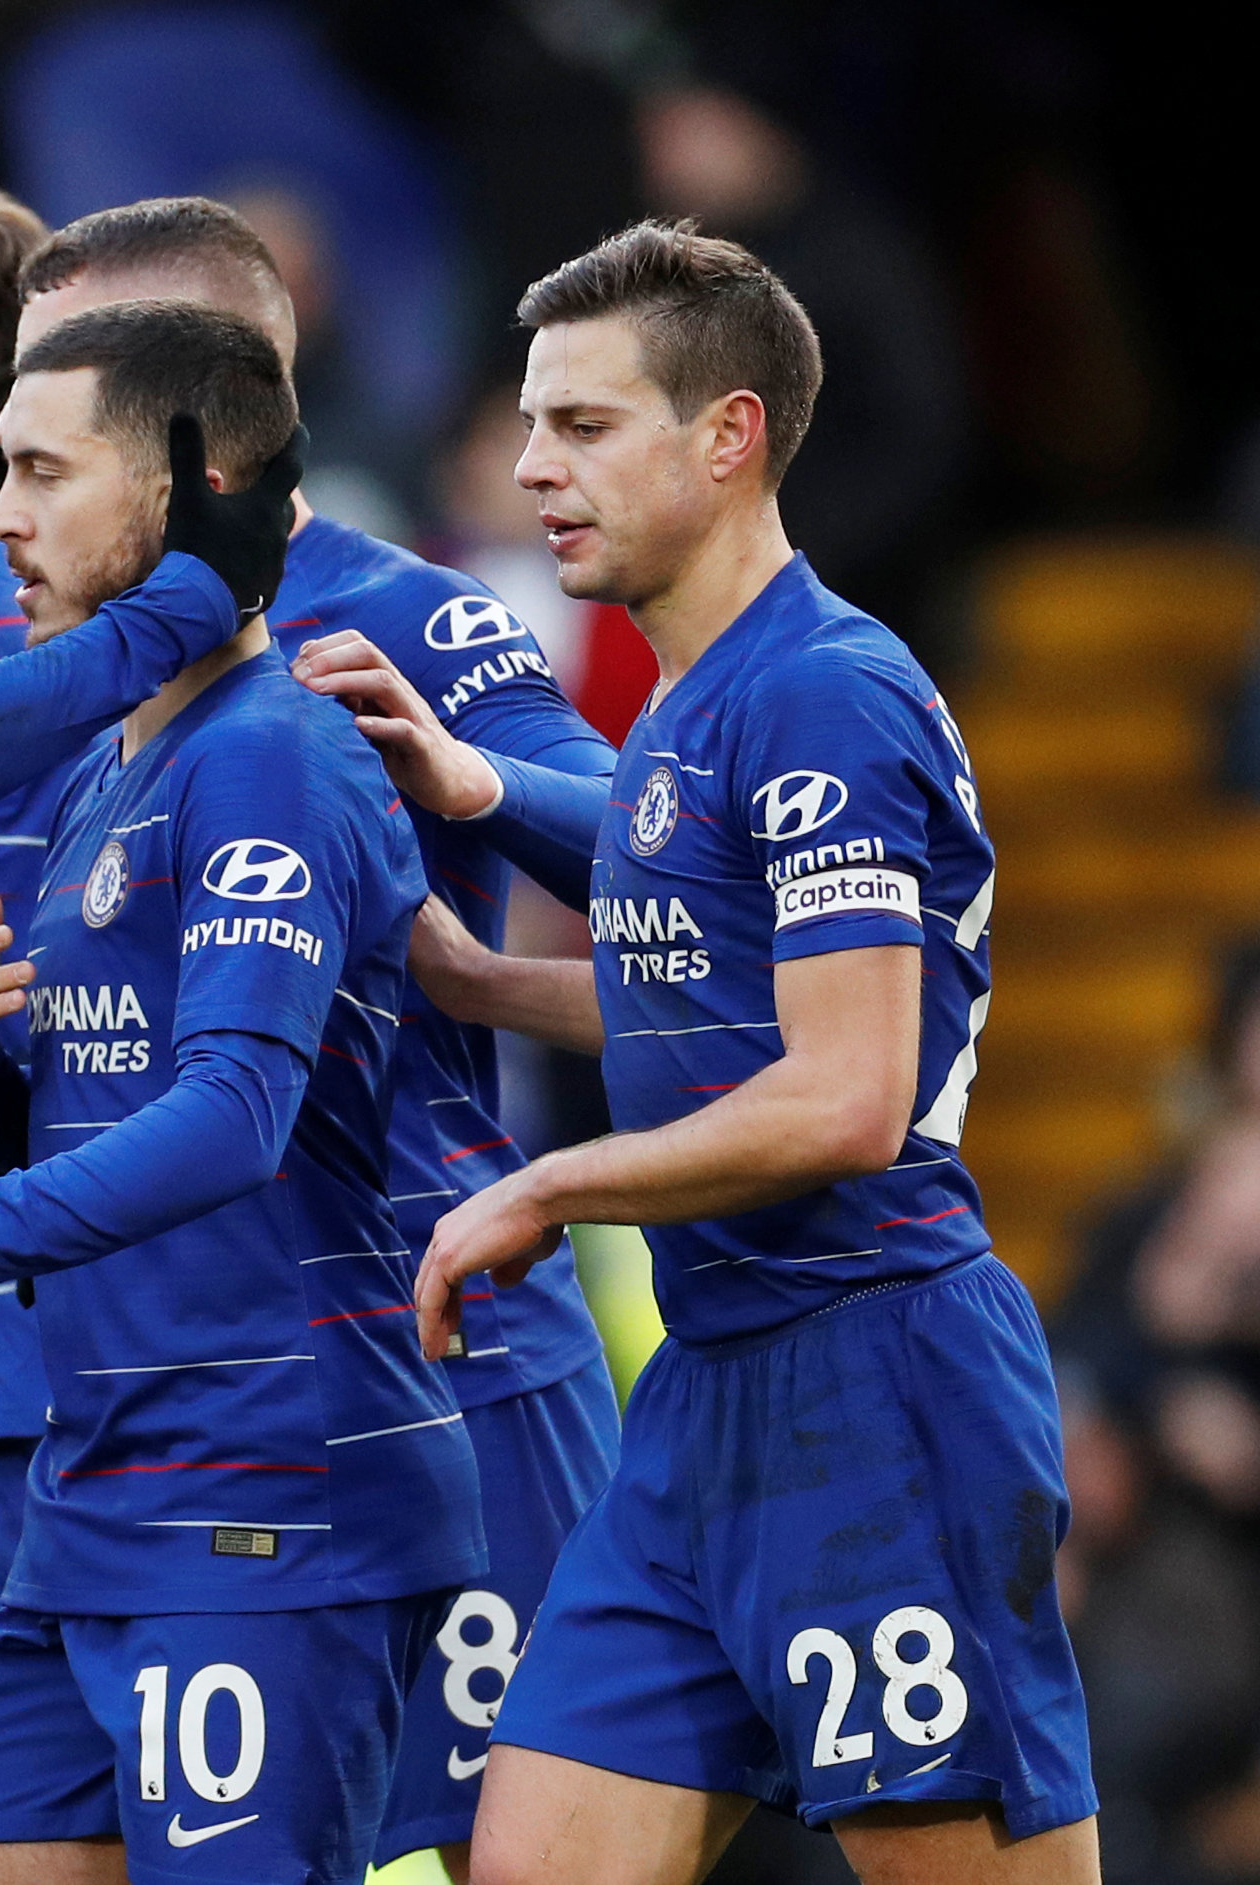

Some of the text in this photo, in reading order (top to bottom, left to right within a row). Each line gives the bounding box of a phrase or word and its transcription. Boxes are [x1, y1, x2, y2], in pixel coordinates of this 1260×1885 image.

[441, 651, 552, 716] HYUND
[765, 836, 885, 891] YUNDAI
[784, 874, 901, 913] Captain
[181, 917, 324, 967] HYUNDAI
[619, 949, 711, 986] TYRES
[62, 1039, 152, 1074] TYRES
[436, 1590, 520, 1729] 8
[787, 1605, 968, 1768] 28
[133, 1662, 267, 1804] 10
